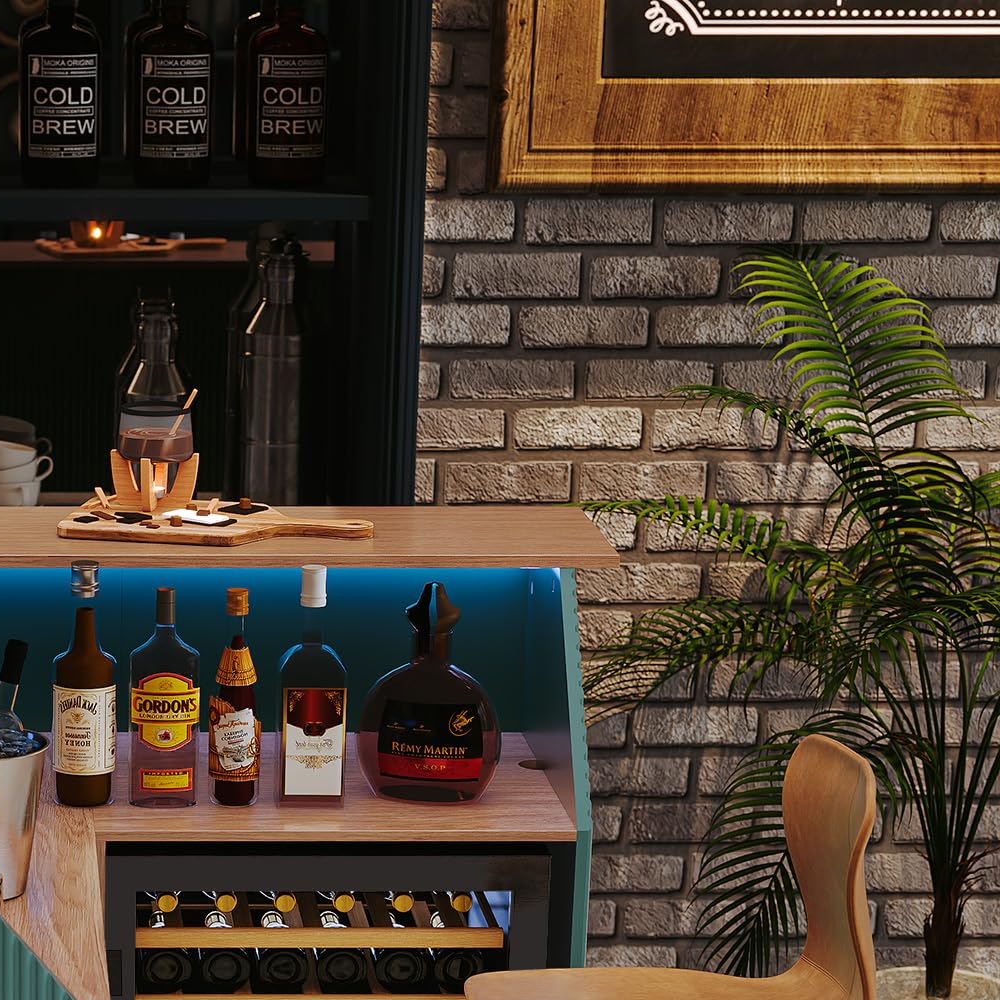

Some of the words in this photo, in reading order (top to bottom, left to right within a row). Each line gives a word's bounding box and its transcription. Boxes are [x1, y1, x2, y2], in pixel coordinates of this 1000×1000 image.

[33, 87, 94, 105] COLD
[146, 87, 206, 105] COLD
[263, 87, 322, 105] COLD
[32, 119, 95, 135] BREW
[145, 119, 207, 135] BREW
[261, 119, 323, 135] BREW
[133, 695, 197, 714] GORDON'S
[392, 741, 422, 753] RÉMY
[424, 744, 466, 755] MARTIN
